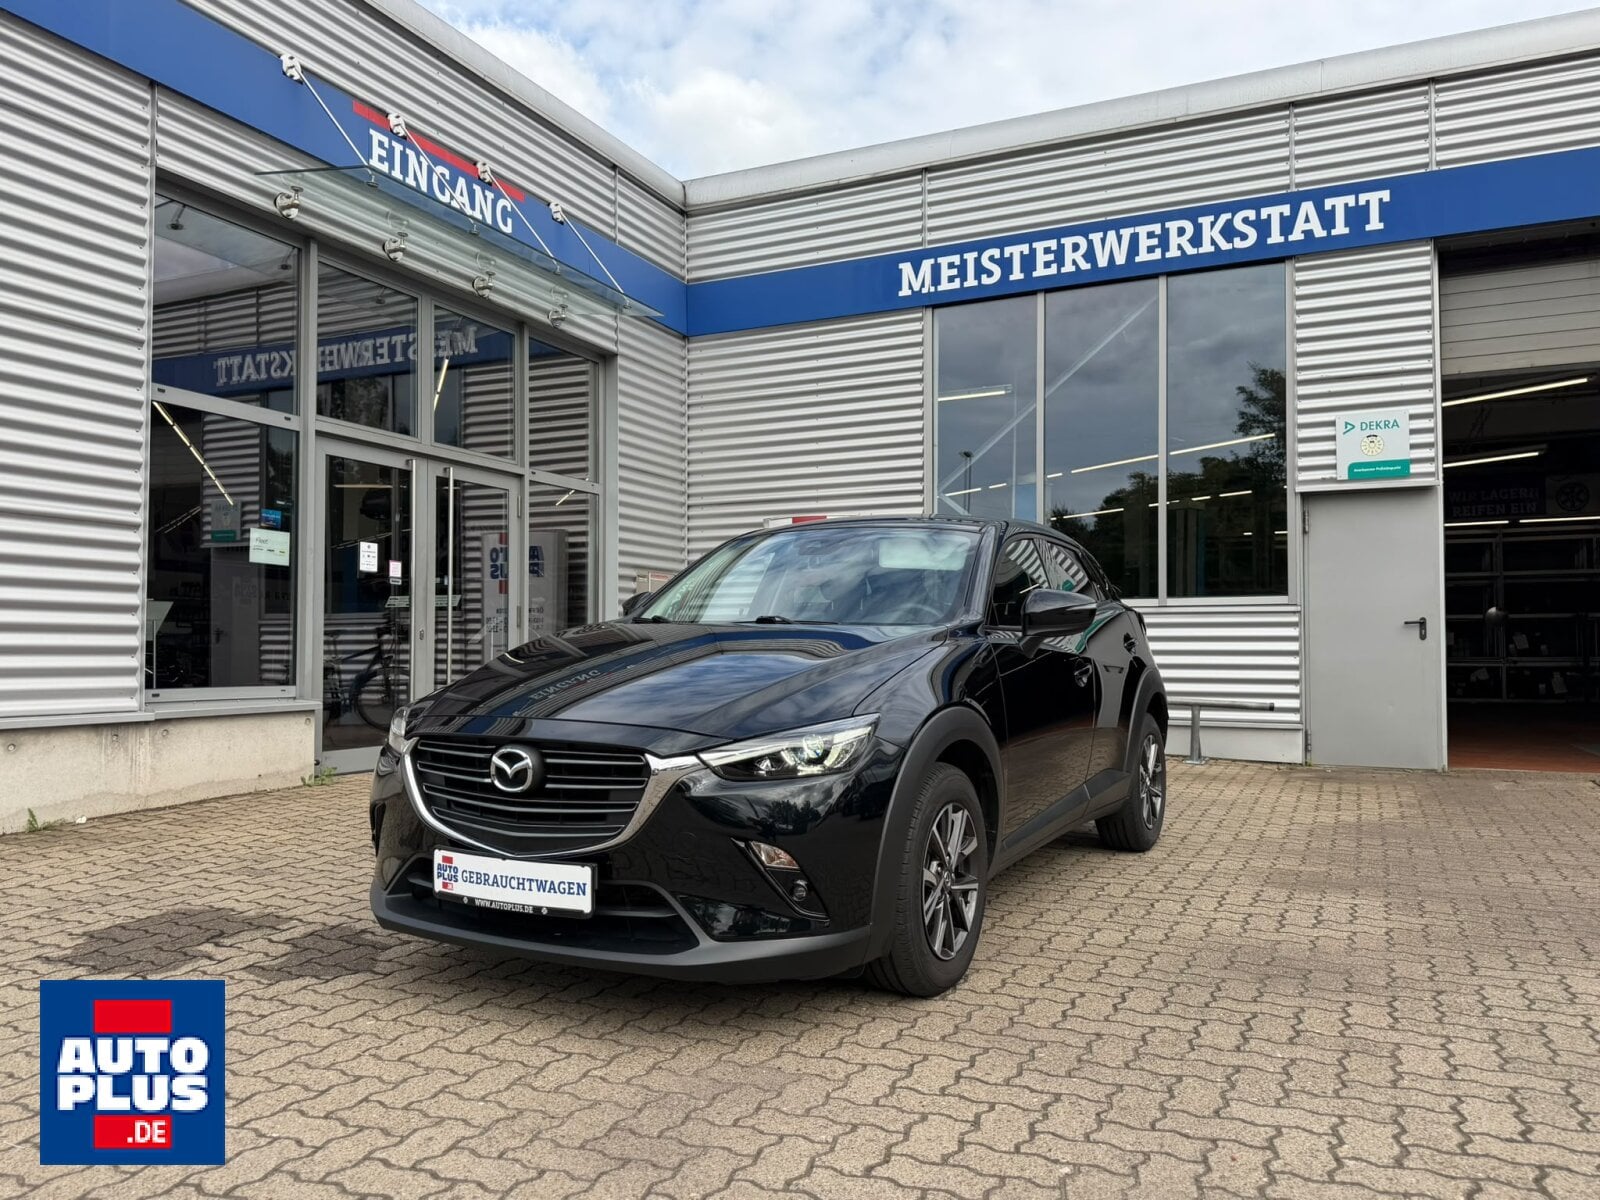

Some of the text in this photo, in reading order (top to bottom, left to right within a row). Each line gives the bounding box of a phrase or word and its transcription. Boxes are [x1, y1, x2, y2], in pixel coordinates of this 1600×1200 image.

[369, 128, 513, 234] EINGANG
[898, 189, 1390, 297] MEISTERWERKSTATT
[1360, 419, 1400, 431] DEKRA
[1452, 501, 1537, 517] REIFEN EIN
[437, 863, 459, 874] AUTO
[437, 871, 459, 882] PLUS
[461, 869, 587, 896] GEBRAUCHTWAGEN
[475, 898, 533, 914] WWW.AUTOPLUS.DE
